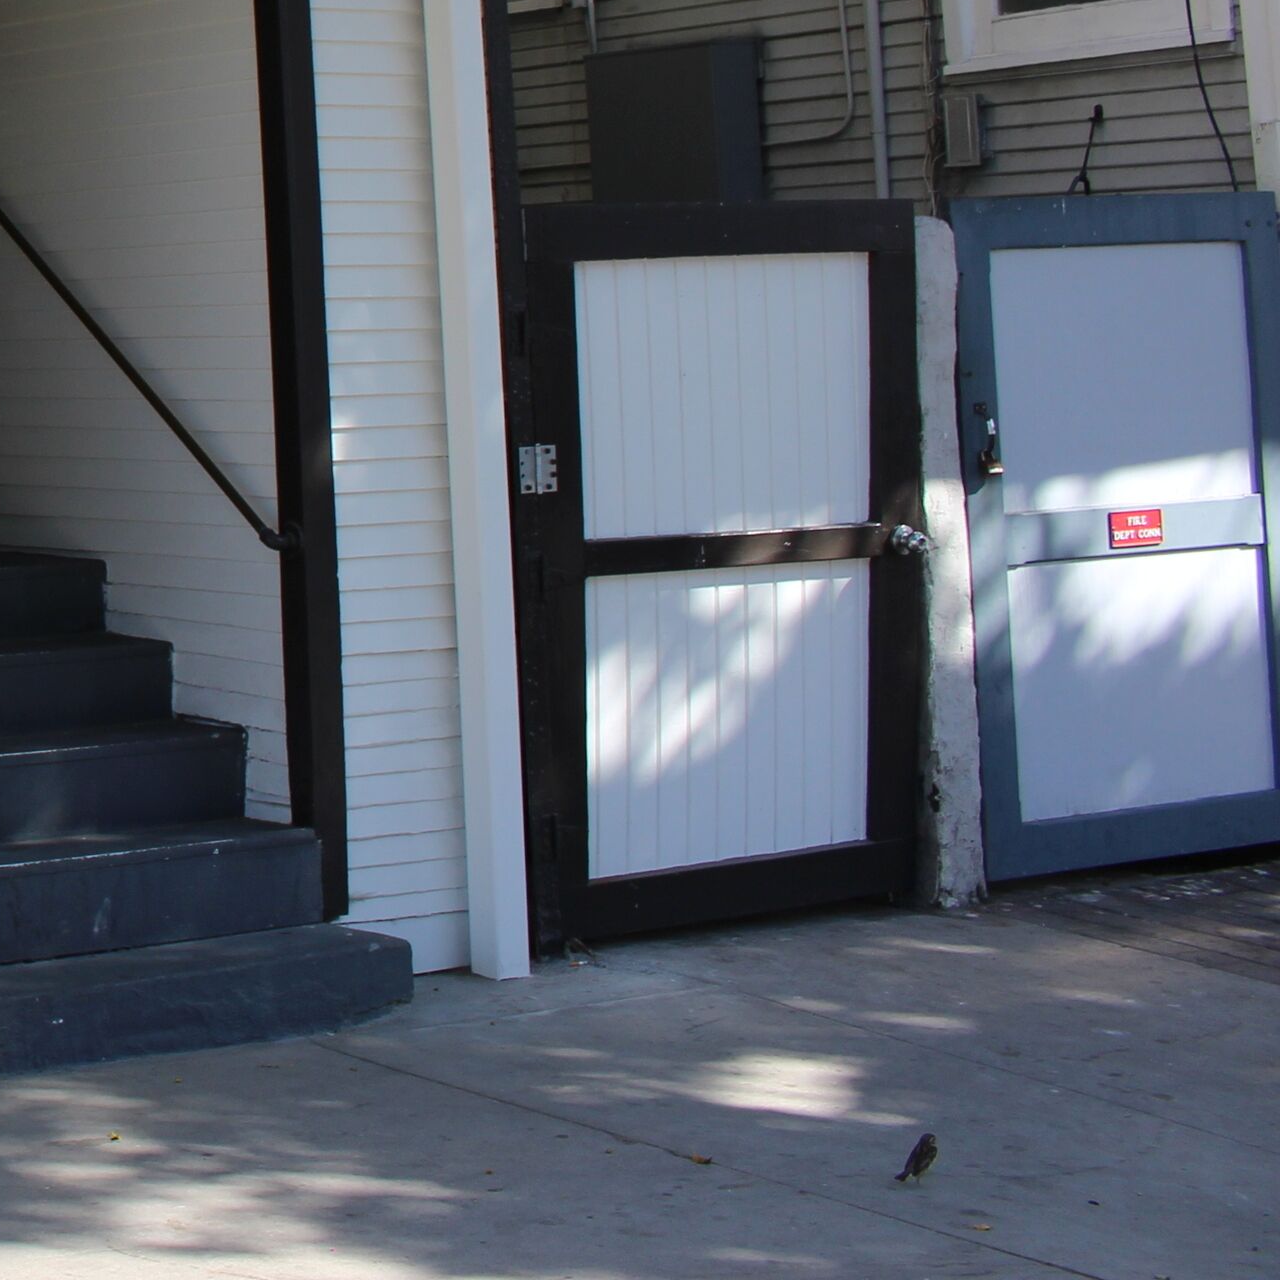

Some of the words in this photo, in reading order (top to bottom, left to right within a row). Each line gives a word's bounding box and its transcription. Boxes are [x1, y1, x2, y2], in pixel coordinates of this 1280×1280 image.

[1127, 515, 1148, 526] FIRE
[1113, 530, 1136, 541] DEPT
[1137, 528, 1161, 539] CONN
